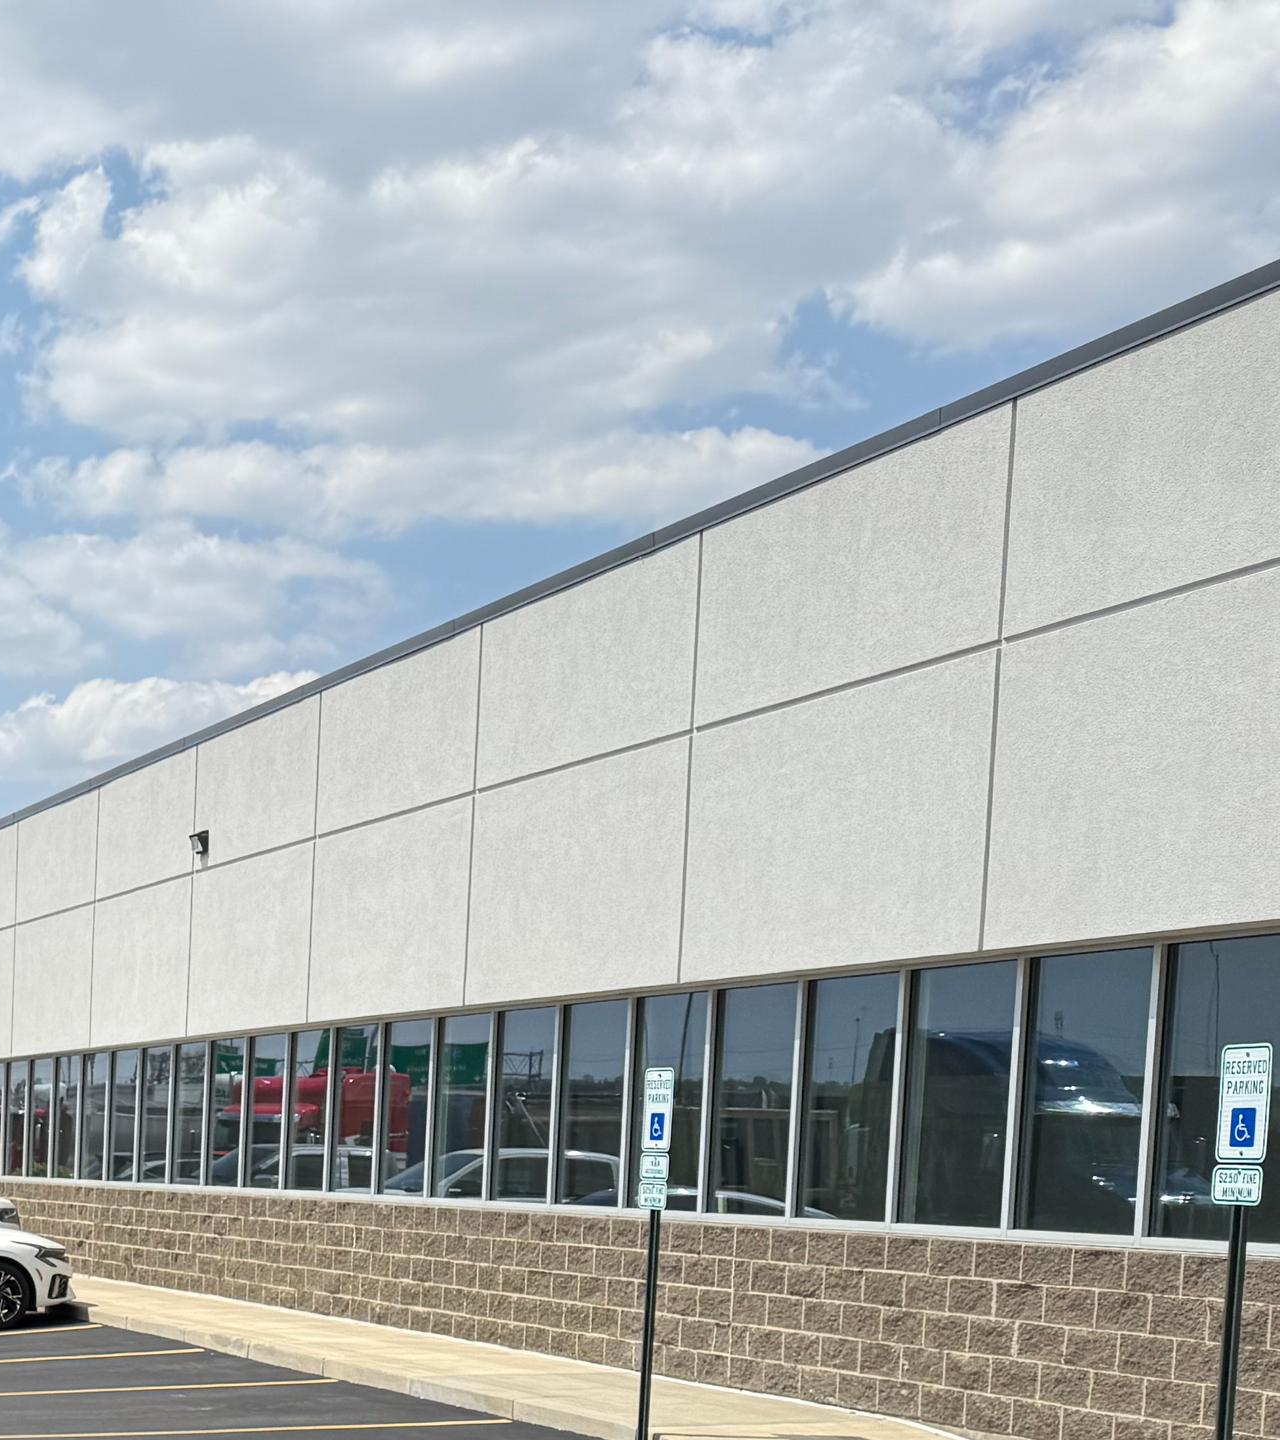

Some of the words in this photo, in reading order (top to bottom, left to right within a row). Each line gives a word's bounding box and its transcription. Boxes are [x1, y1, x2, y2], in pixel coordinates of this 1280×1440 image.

[1225, 1059, 1268, 1075] RESERVED
[1226, 1080, 1264, 1095] PARKING
[1218, 1172, 1239, 1184] $250
[1242, 1173, 1258, 1185] FINE
